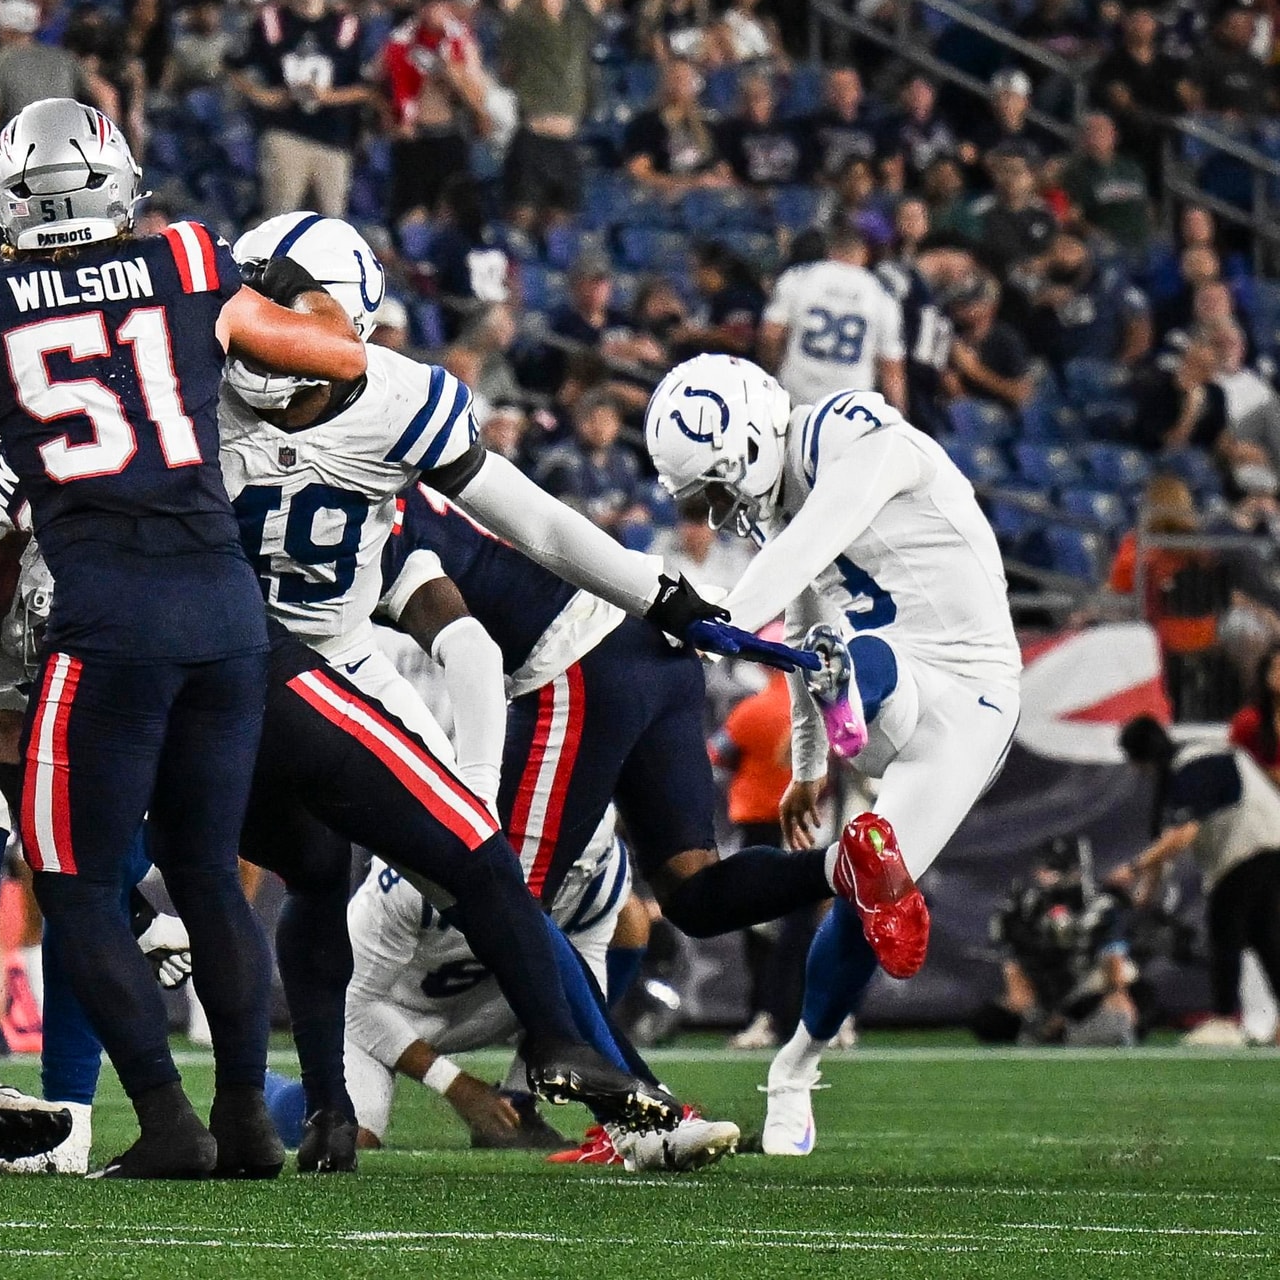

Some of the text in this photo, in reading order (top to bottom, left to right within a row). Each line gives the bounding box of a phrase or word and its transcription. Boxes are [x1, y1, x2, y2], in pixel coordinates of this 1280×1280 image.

[37, 226, 93, 247] PATRIOTS
[40, 196, 74, 222] 51
[6, 256, 155, 313] WILSON
[800, 306, 868, 365] 28
[1, 304, 204, 484] 51
